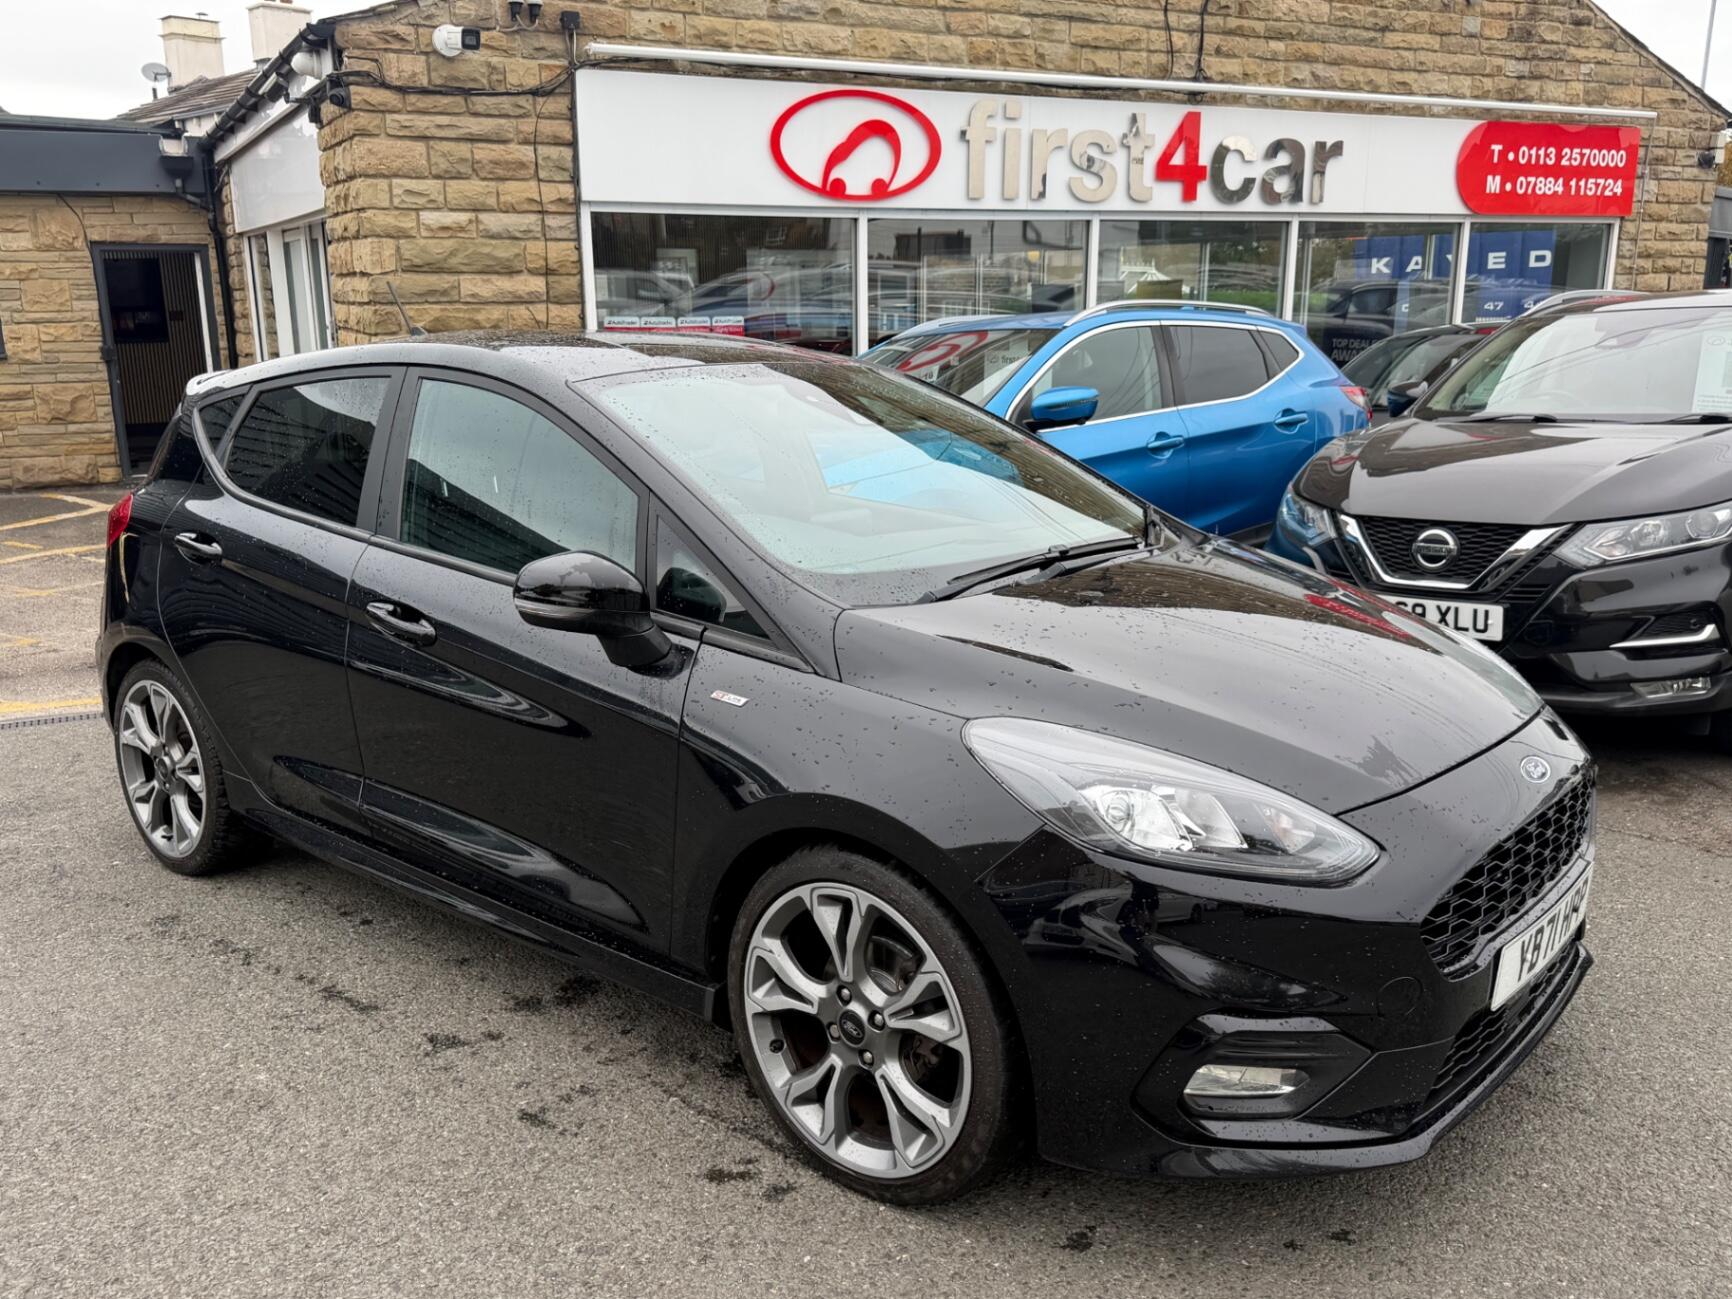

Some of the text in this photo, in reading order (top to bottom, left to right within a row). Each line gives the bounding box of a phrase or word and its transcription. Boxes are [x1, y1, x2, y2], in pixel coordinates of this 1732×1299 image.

[960, 101, 1344, 206] first4car
[1490, 144, 1627, 167] T 0113 2570000
[1485, 175, 1622, 196] M 07884 115724
[1371, 250, 1552, 274] KAED
[1436, 604, 1489, 633] XLU
